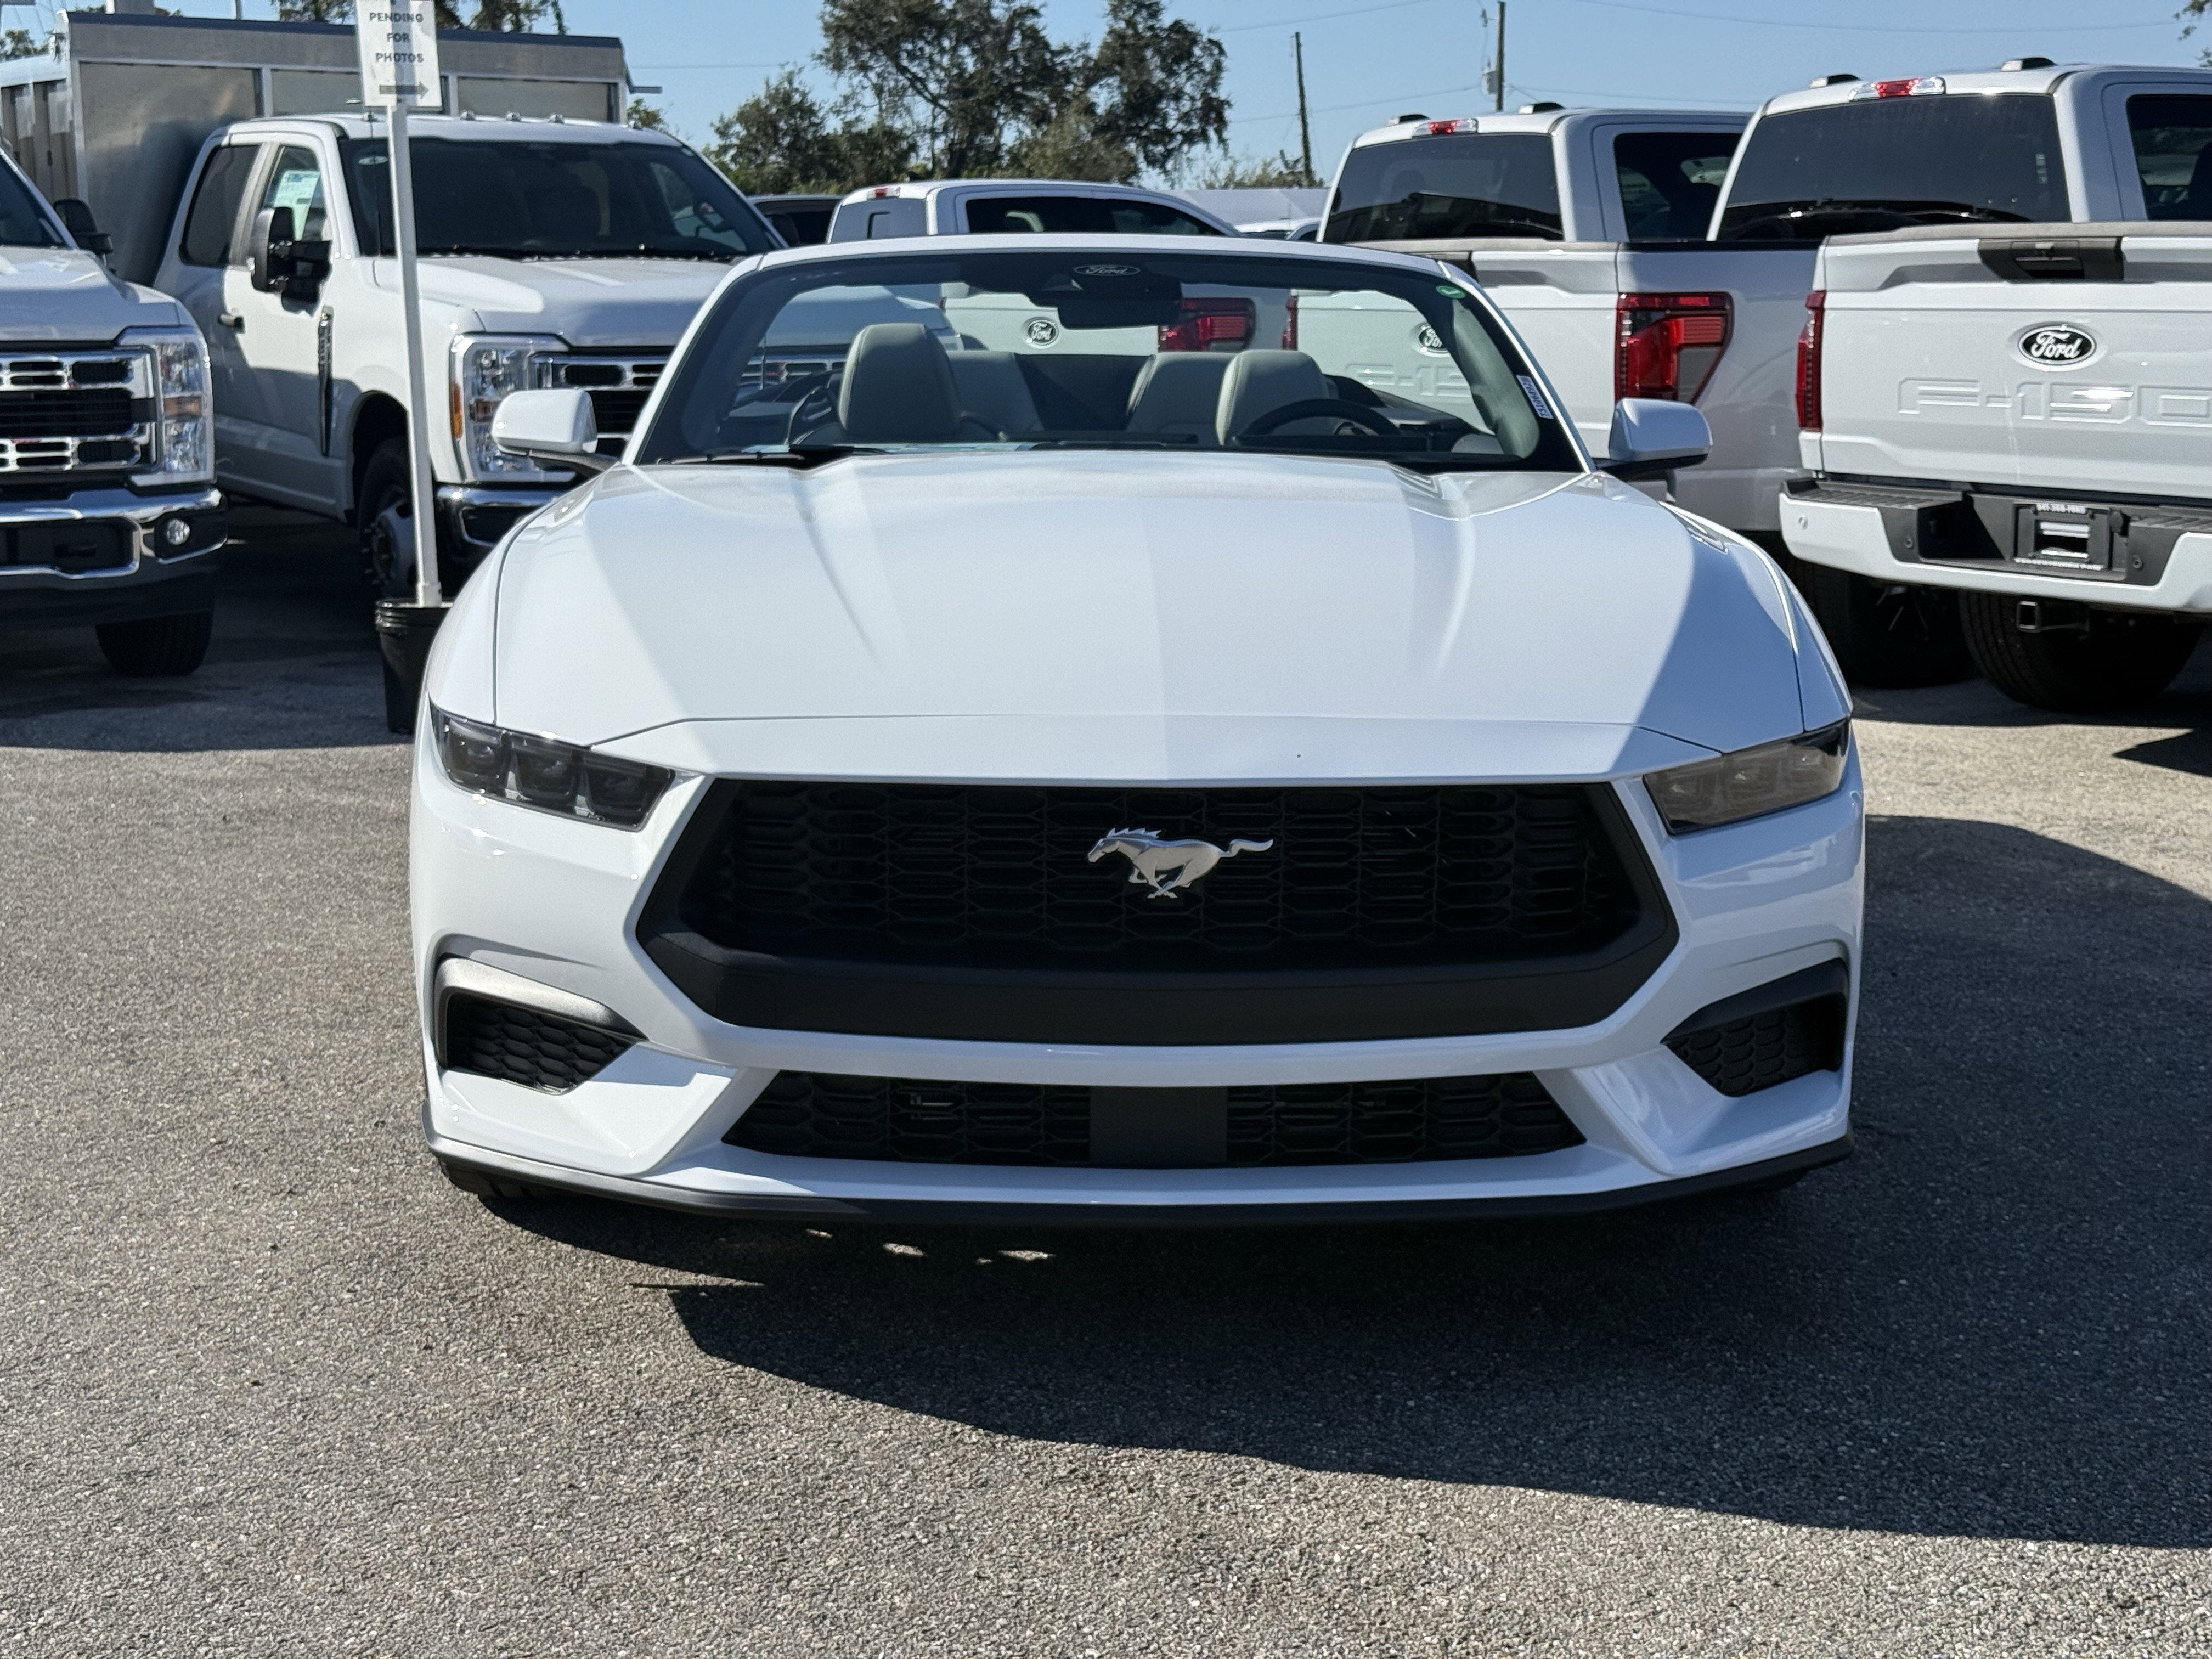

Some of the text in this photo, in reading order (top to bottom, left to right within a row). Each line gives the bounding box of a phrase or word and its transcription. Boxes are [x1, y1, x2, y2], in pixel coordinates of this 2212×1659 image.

[369, 12, 424, 23] PENDING
[387, 33, 410, 43] FOR
[375, 53, 424, 63] PHOTOS
[1086, 265, 1128, 274] Ford
[1032, 323, 1052, 340] Ford
[2030, 331, 2083, 358] Ford
[1898, 377, 2212, 427] F-150
